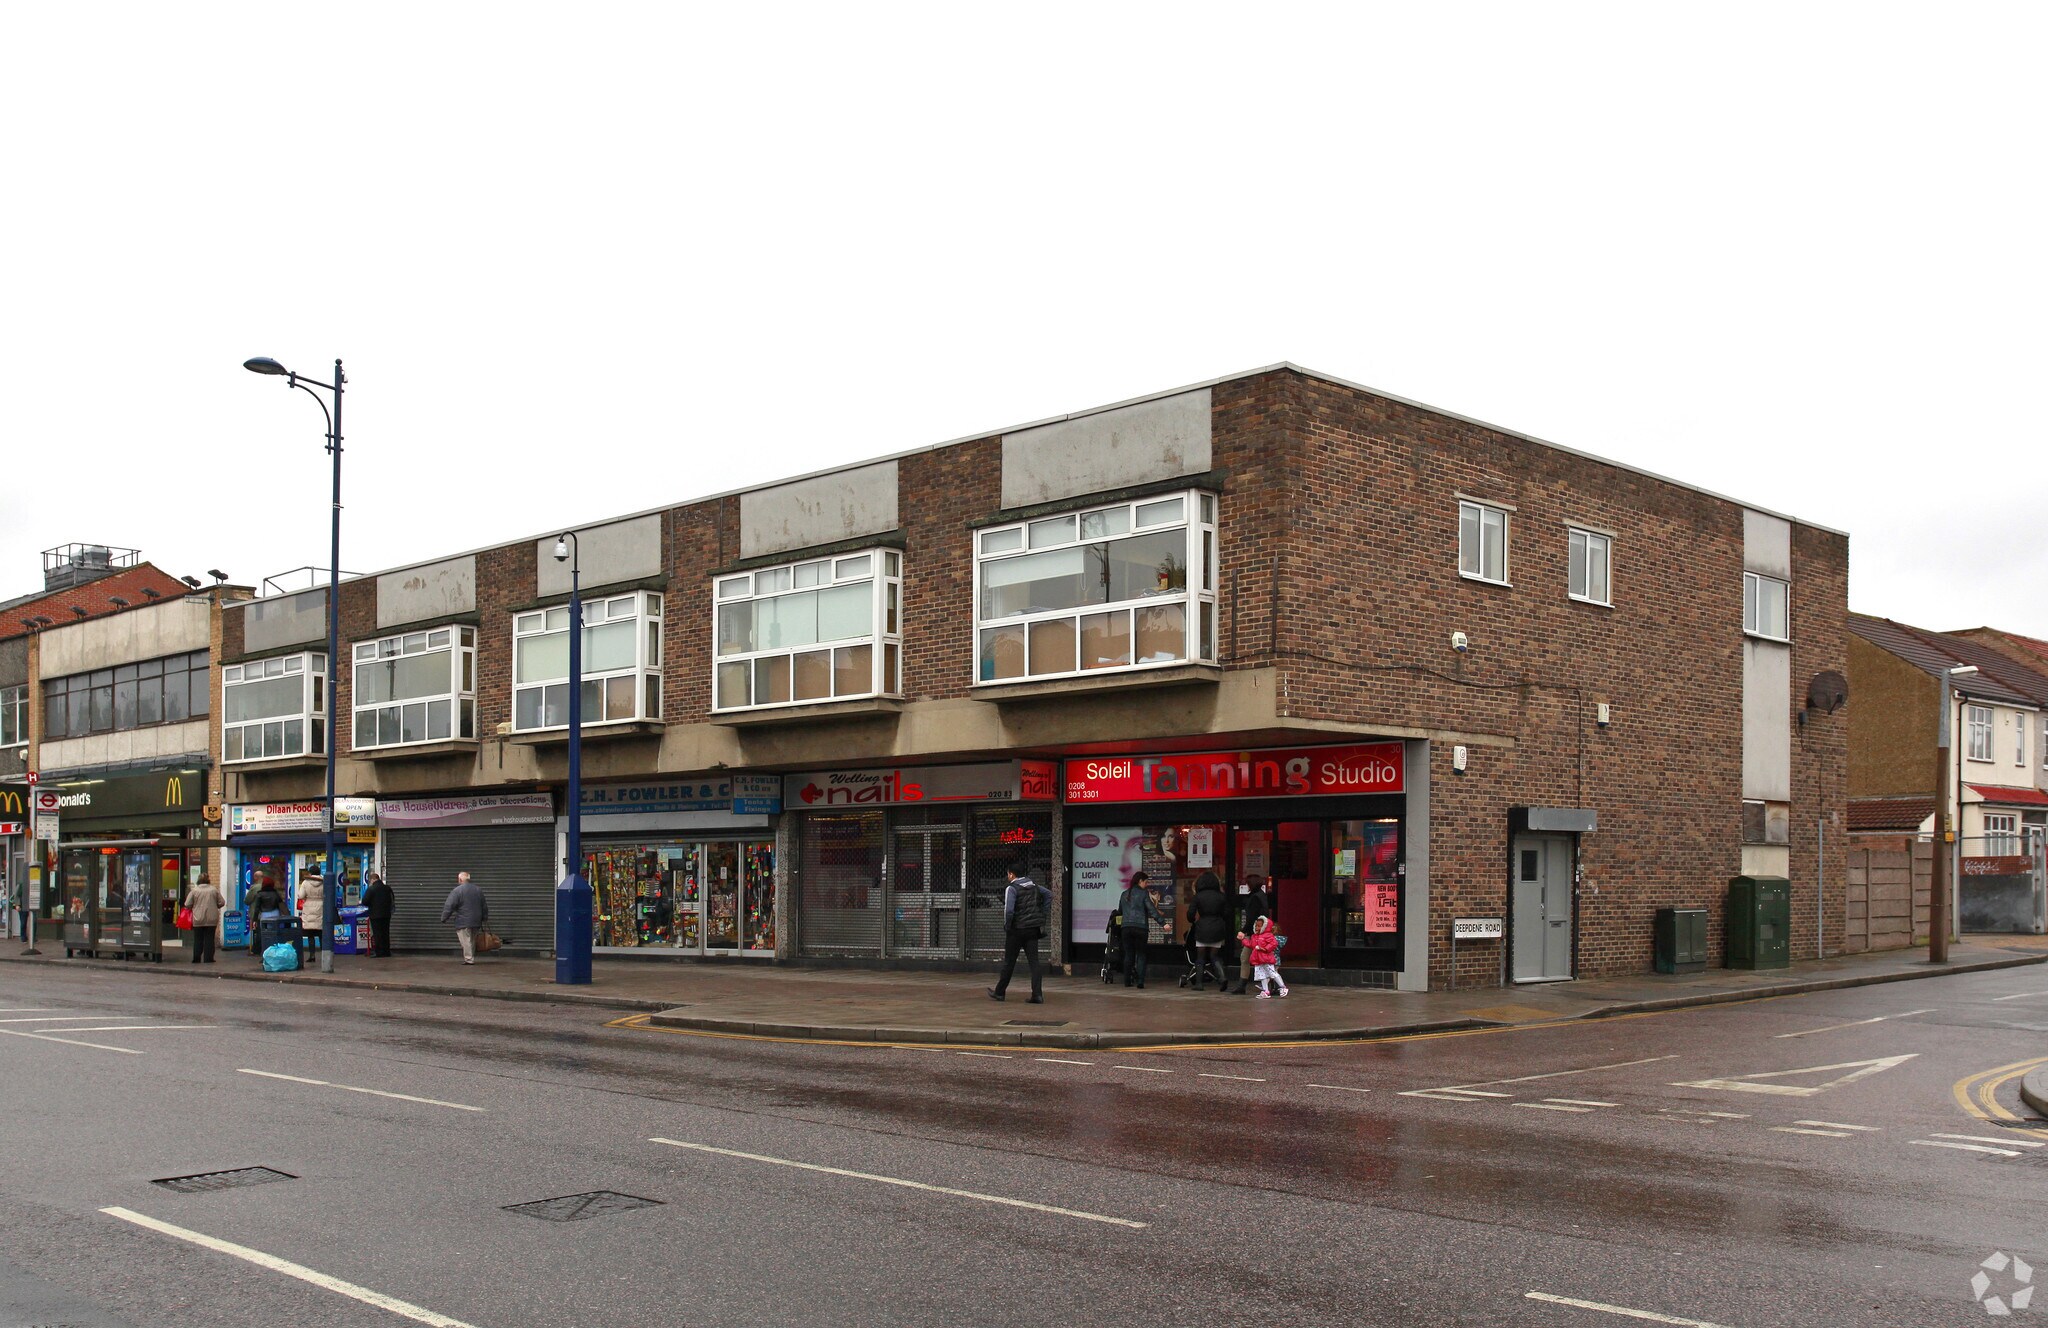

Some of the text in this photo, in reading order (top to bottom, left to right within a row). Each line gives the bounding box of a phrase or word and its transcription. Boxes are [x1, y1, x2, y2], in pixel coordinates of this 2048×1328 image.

[1086, 752, 1396, 794] Soleil Tanning Studio
[751, 776, 779, 784] FOWLER
[828, 773, 880, 785] Welling
[1021, 768, 1058, 795] nails
[827, 770, 924, 805] nails
[1068, 783, 1085, 791] 0208
[617, 784, 693, 801] FOWLER
[699, 784, 713, 798] &
[718, 783, 730, 797] C
[1003, 790, 1012, 798] 83
[1068, 790, 1099, 799] 301 3301
[381, 802, 401, 813] Has
[478, 797, 497, 806] Cake
[500, 795, 547, 805] Decorations
[266, 804, 291, 815] Dilaan
[292, 803, 312, 813] Food
[350, 813, 374, 822] oyster
[1075, 861, 1109, 869] COLLAGEN
[1081, 871, 1101, 879] LIGHT
[1076, 882, 1107, 890] THERAPY
[1455, 923, 1501, 933] DEEPDENE ROAD
